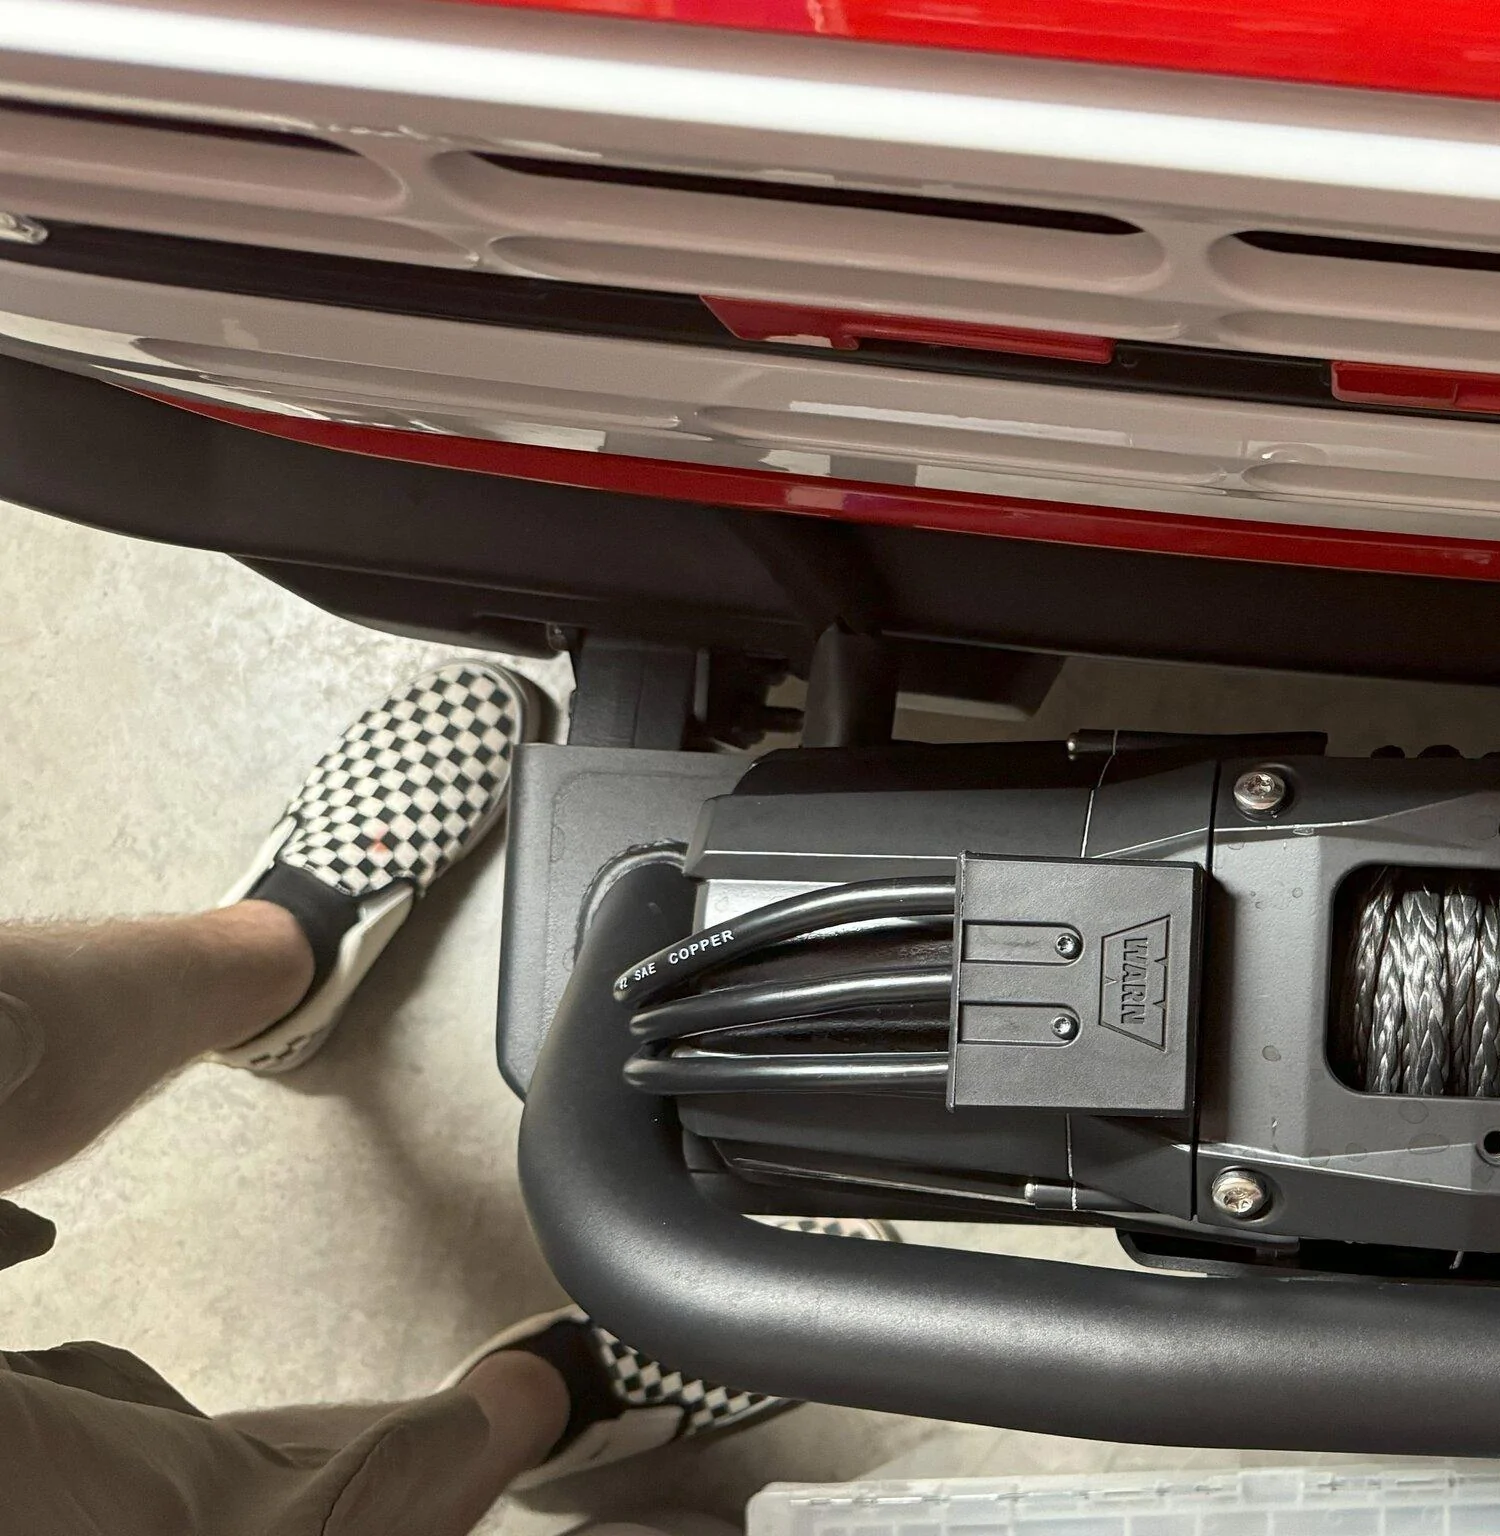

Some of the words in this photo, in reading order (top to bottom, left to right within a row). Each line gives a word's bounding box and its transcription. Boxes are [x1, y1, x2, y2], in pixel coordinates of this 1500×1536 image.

[634, 962, 657, 981] SAE
[668, 929, 735, 965] COPPER
[1120, 938, 1148, 1024] WARN
